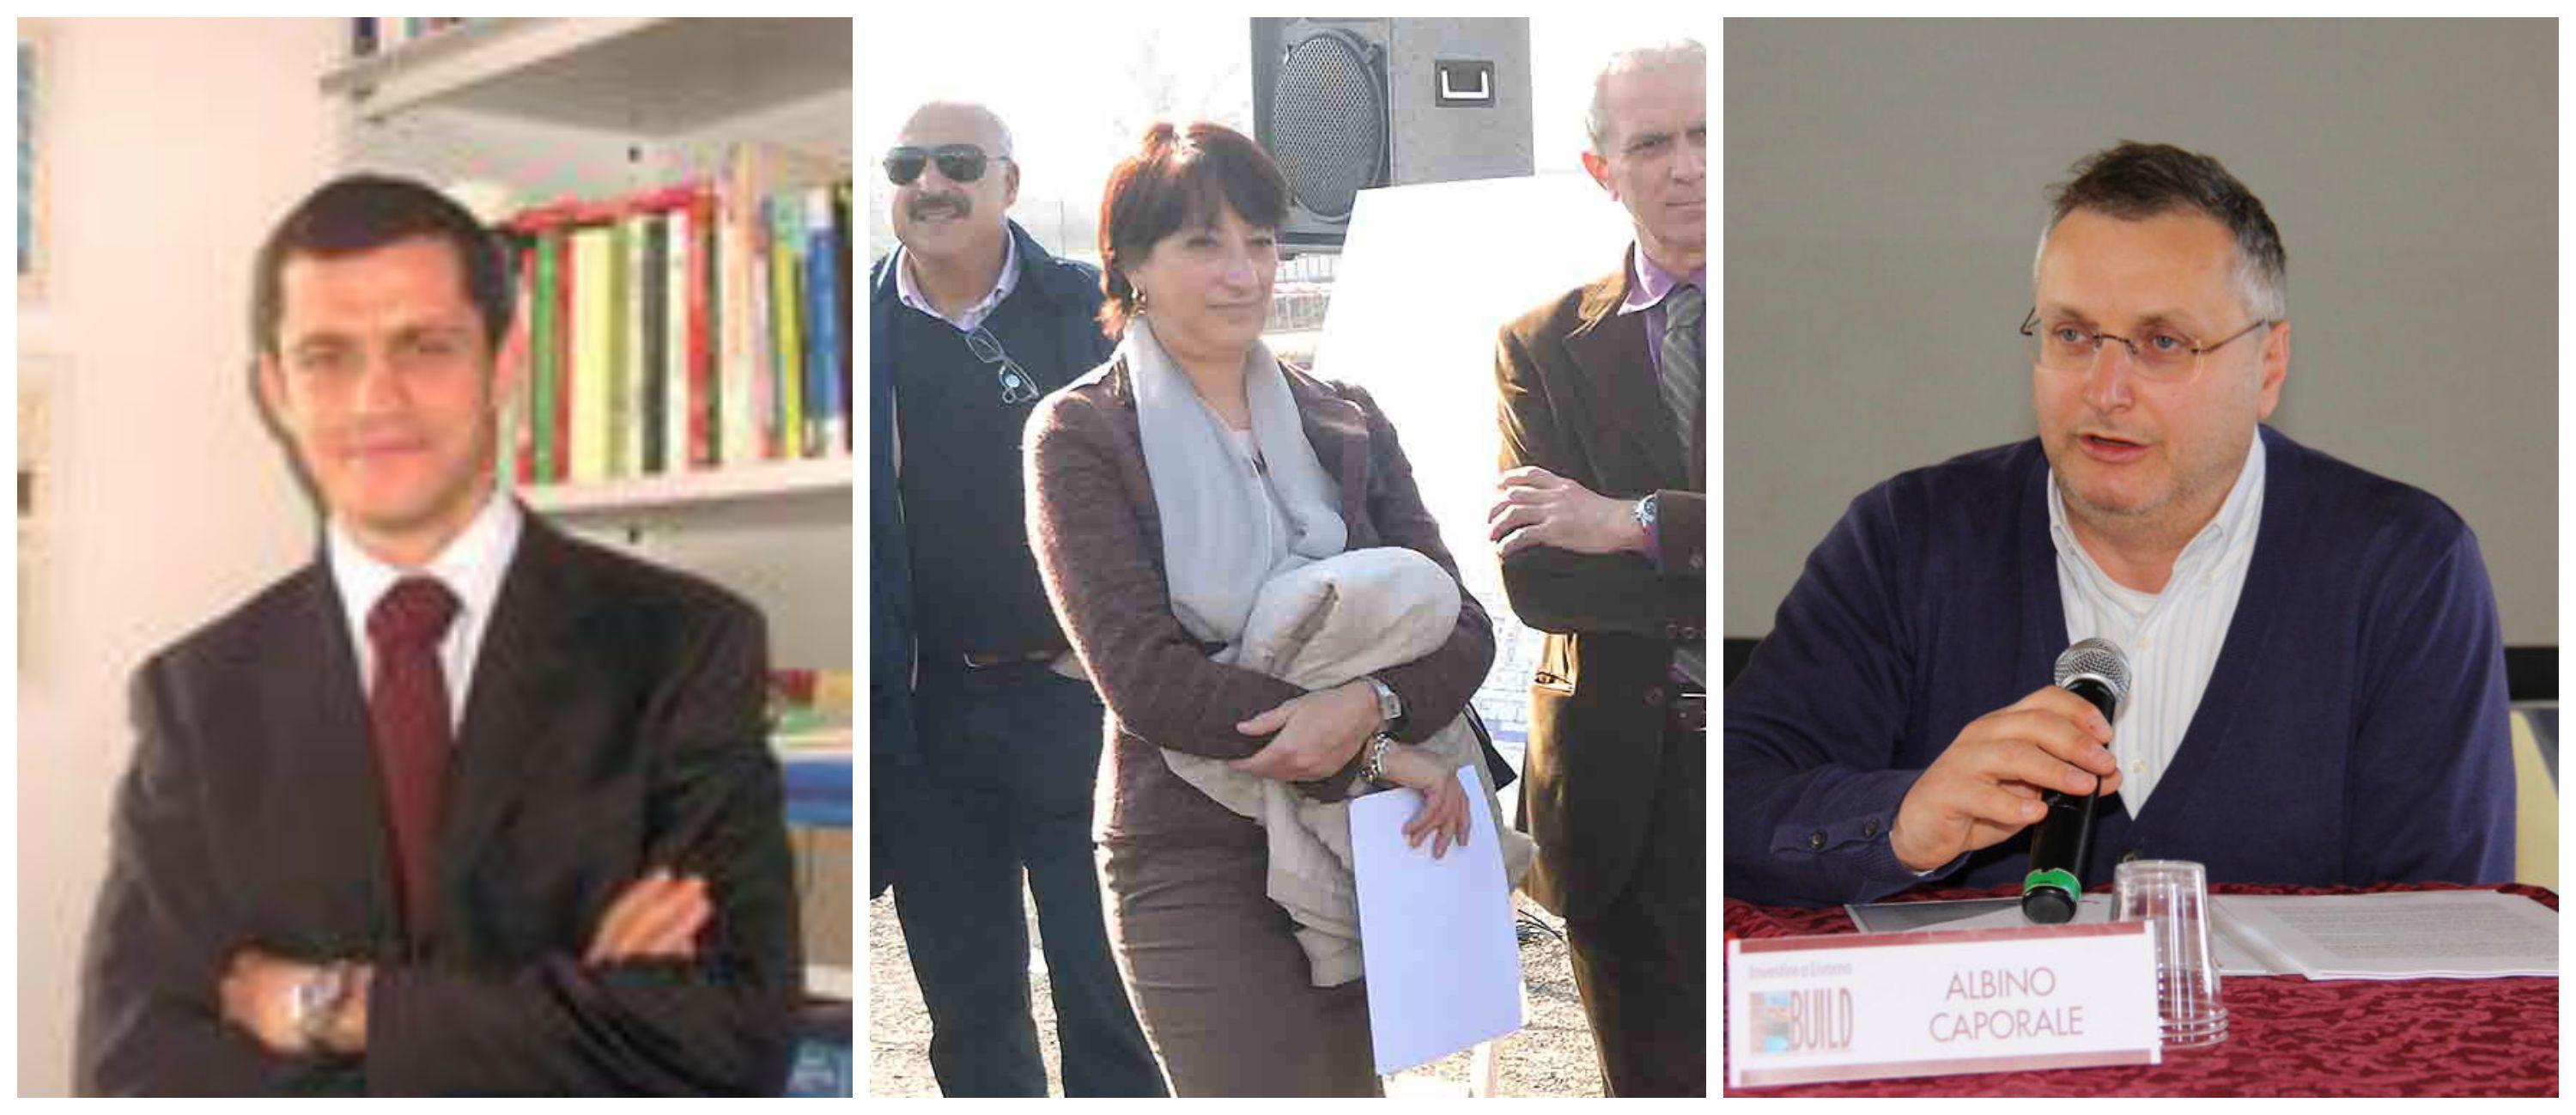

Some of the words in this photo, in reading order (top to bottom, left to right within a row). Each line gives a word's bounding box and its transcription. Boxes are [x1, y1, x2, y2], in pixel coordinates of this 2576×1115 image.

[1945, 966, 2056, 1000] ALBINO
[1789, 987, 1854, 1051] BUILD
[1929, 1006, 2084, 1042] CAPORALE
